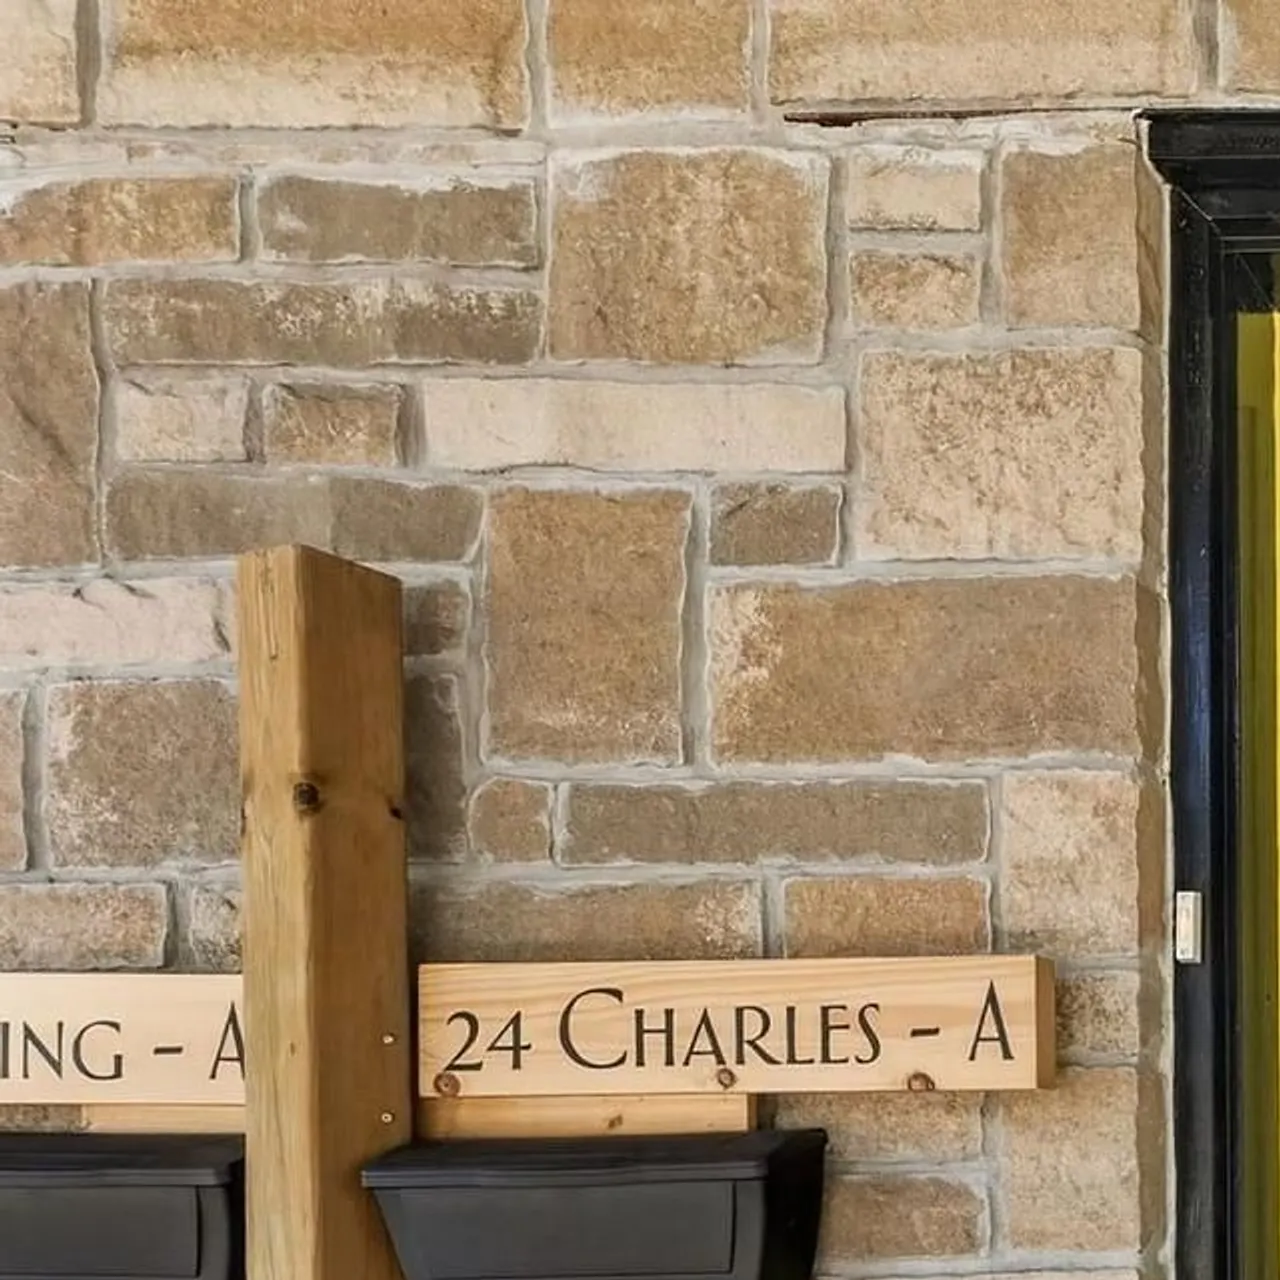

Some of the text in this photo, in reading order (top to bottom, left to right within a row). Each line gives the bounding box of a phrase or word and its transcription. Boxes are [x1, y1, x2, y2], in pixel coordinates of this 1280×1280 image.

[208, 1000, 246, 1081] A
[443, 1010, 532, 1072] 24
[968, 980, 1014, 1061] A
